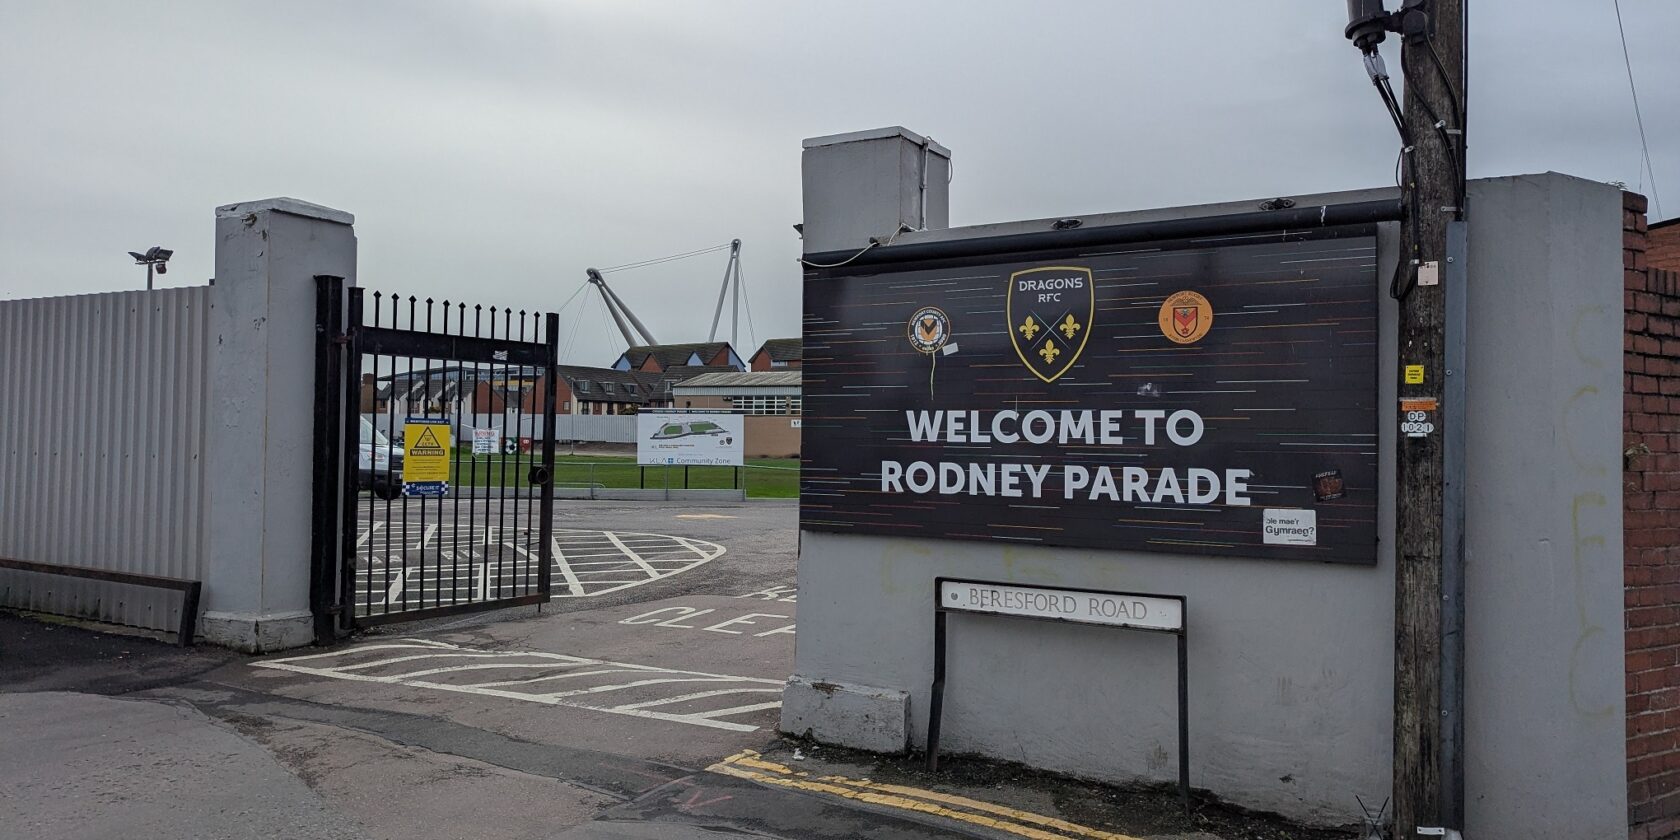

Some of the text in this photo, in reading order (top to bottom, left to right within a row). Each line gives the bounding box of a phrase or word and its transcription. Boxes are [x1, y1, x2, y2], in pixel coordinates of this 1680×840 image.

[1019, 278, 1083, 291] DRAGONS
[1038, 293, 1061, 303] RFC
[1409, 412, 1424, 420] DP
[906, 409, 1204, 446] WELCOME TO
[676, 457, 713, 465] Community
[881, 460, 1251, 506] RODNEY PARADE
[1265, 525, 1315, 537] Gymraeg?
[969, 588, 1148, 620] BERESFORD ROAD
